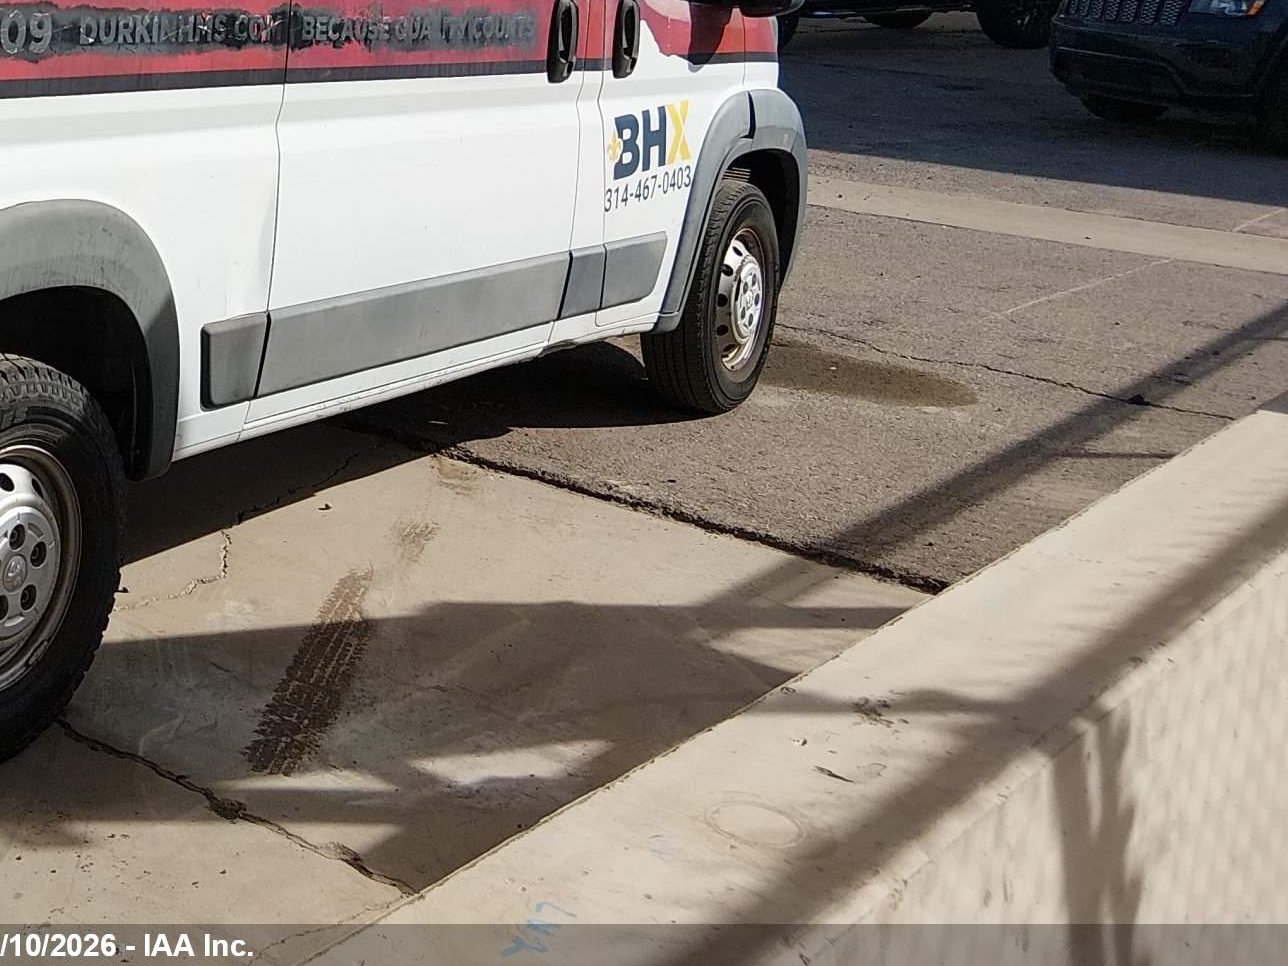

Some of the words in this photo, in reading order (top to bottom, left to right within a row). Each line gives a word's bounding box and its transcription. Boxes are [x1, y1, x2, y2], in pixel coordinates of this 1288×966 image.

[301, 15, 391, 42] BECAUSE
[614, 101, 691, 180] BHX
[604, 165, 692, 212] 314-467-0403
